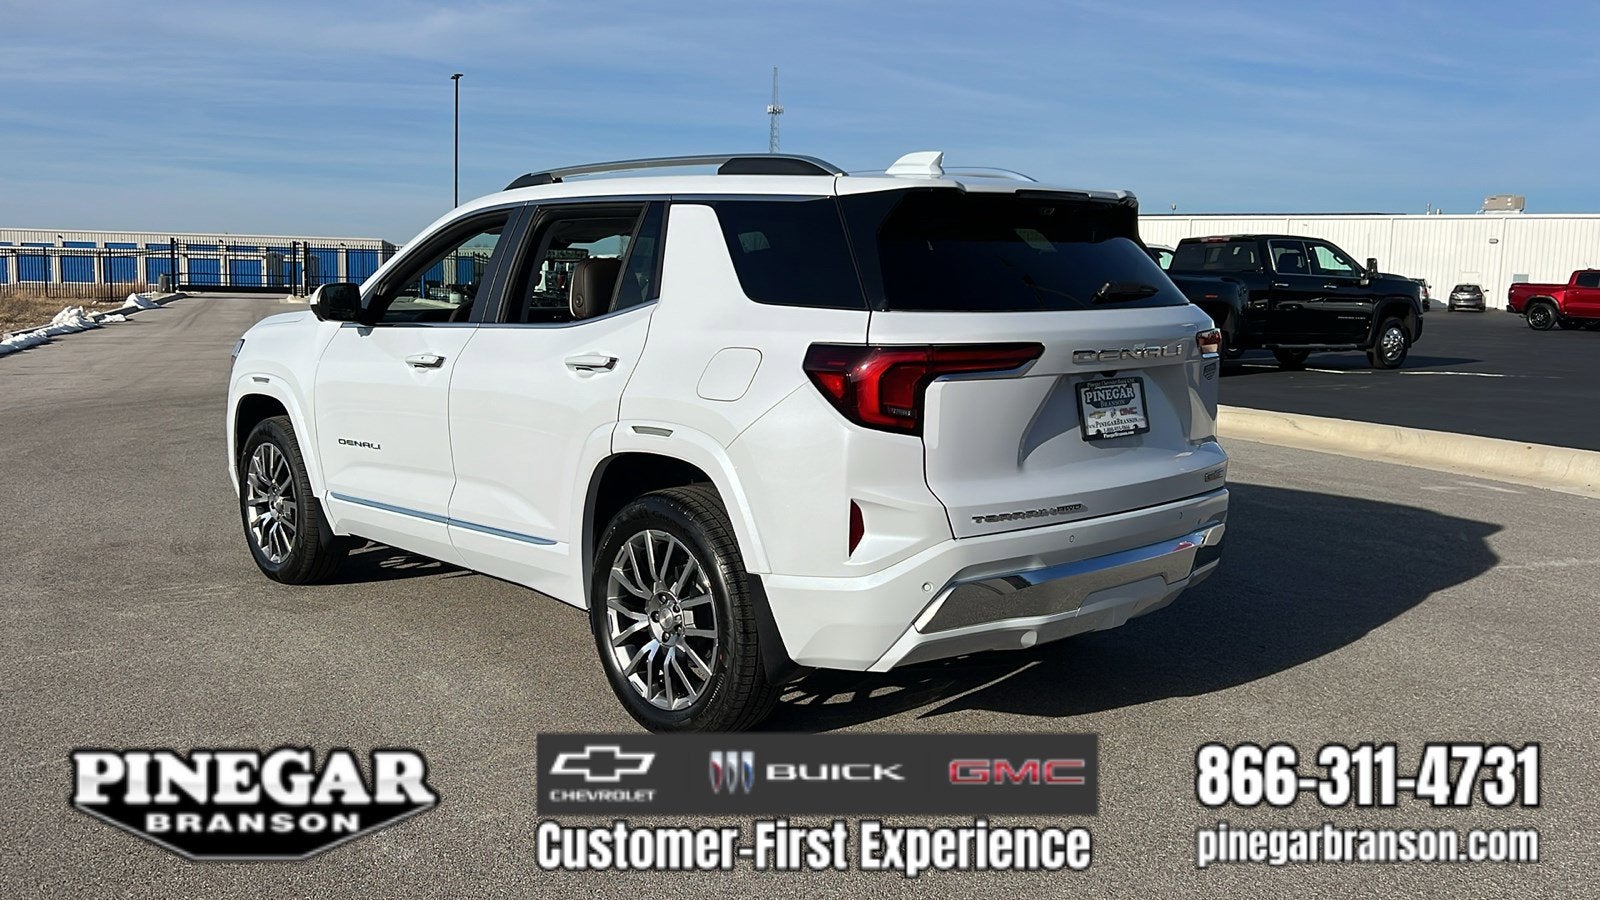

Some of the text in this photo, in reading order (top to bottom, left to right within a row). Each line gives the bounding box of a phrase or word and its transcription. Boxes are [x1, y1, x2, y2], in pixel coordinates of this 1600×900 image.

[1072, 344, 1182, 364] DENALI
[1085, 387, 1135, 403] PINEGAR
[1100, 400, 1126, 408] BRANSON
[338, 438, 381, 450] DENALI
[971, 507, 1057, 524] TERRAIN
